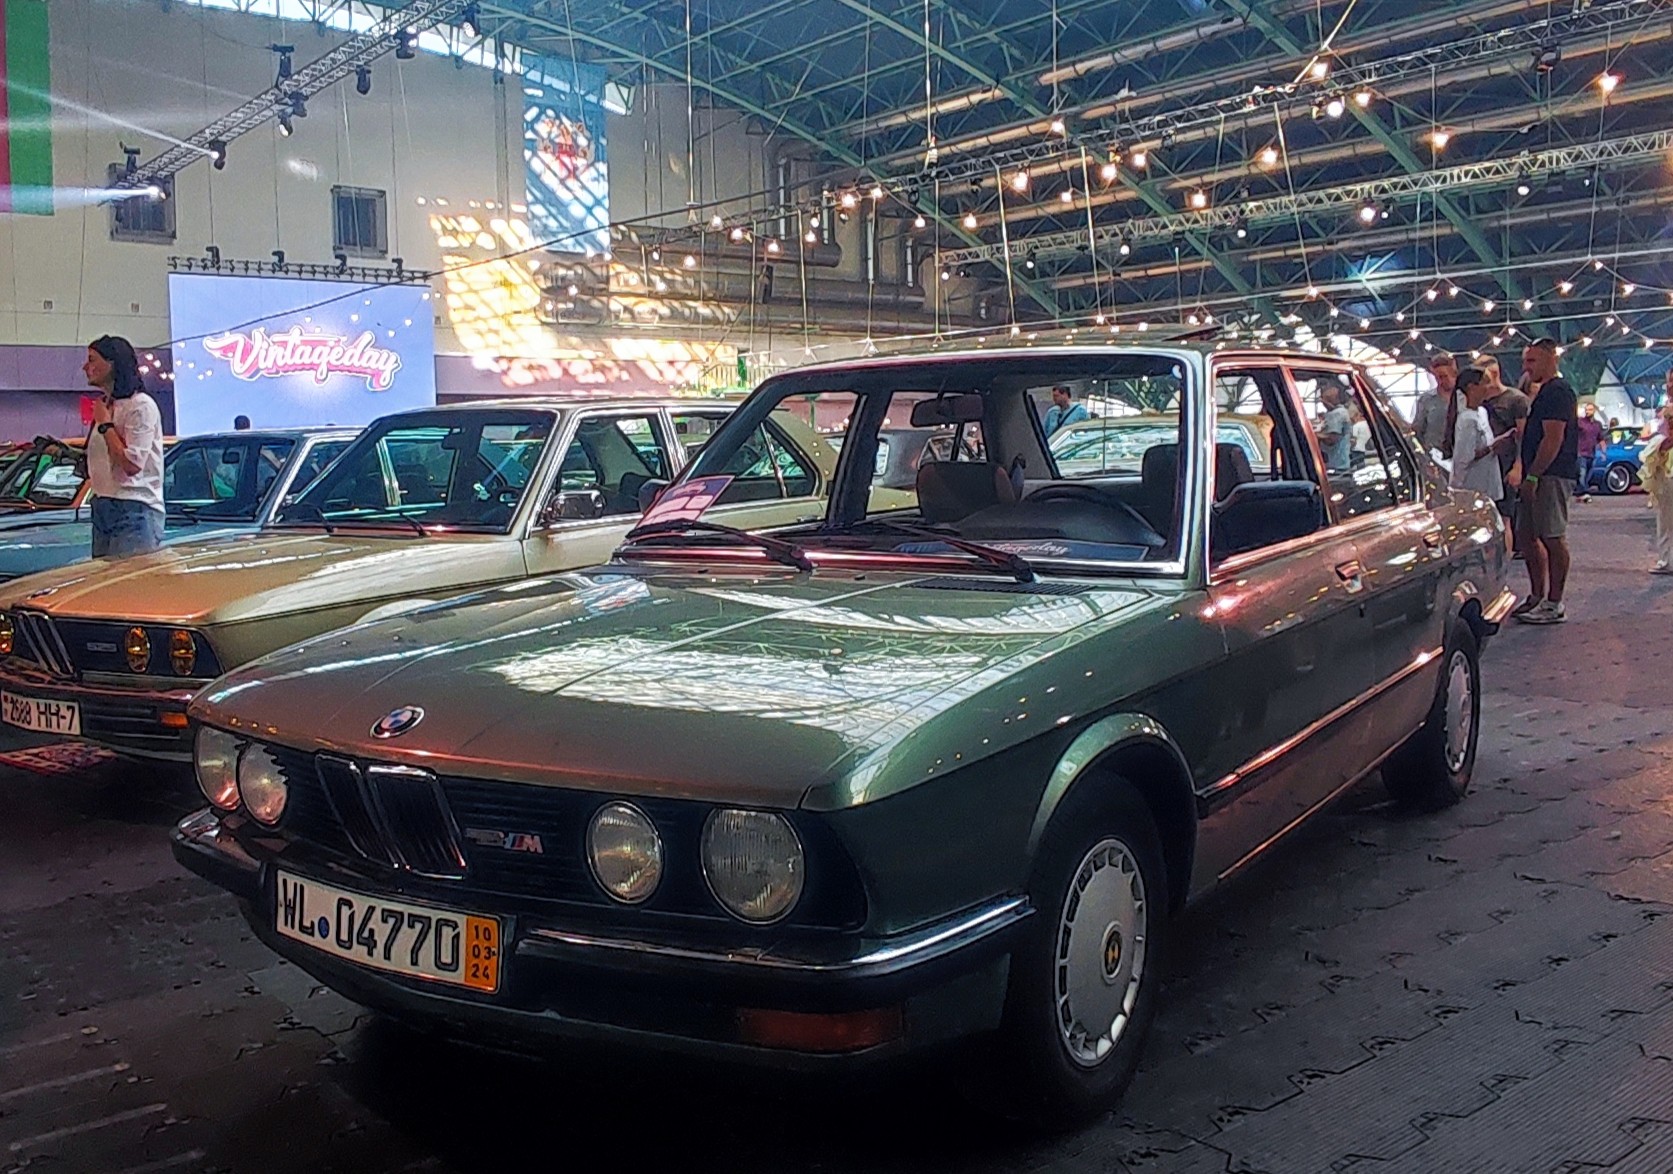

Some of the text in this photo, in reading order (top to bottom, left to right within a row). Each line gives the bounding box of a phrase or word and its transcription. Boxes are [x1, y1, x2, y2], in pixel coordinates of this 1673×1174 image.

[204, 325, 401, 388] Vintageday
[336, 897, 461, 973] 04770
[474, 925, 492, 942] 10
[472, 946, 492, 961] 03
[471, 963, 491, 980] 24
